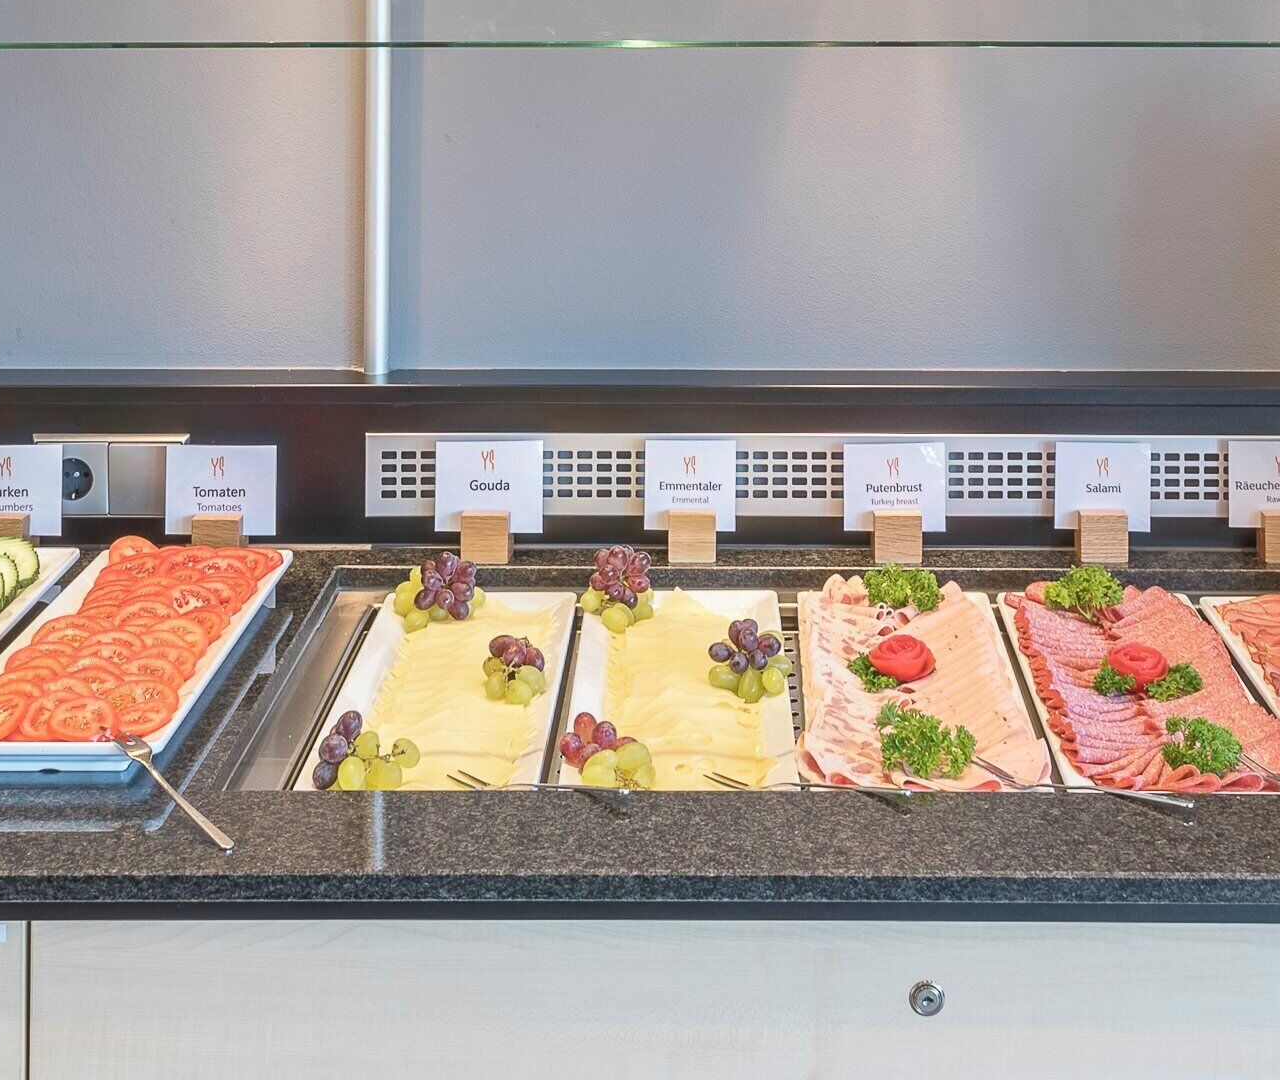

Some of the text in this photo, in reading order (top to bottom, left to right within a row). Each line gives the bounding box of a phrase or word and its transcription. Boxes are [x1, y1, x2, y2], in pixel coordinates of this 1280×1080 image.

[469, 479, 510, 491] Gouda
[659, 481, 722, 492] Emmentaler
[866, 483, 922, 493] Putenbrust
[1086, 483, 1121, 493] Salami
[193, 486, 246, 498] Tomaten
[671, 496, 709, 504] Emmental
[870, 497, 918, 507] Turkey breast
[197, 502, 242, 512] Tomatoes
